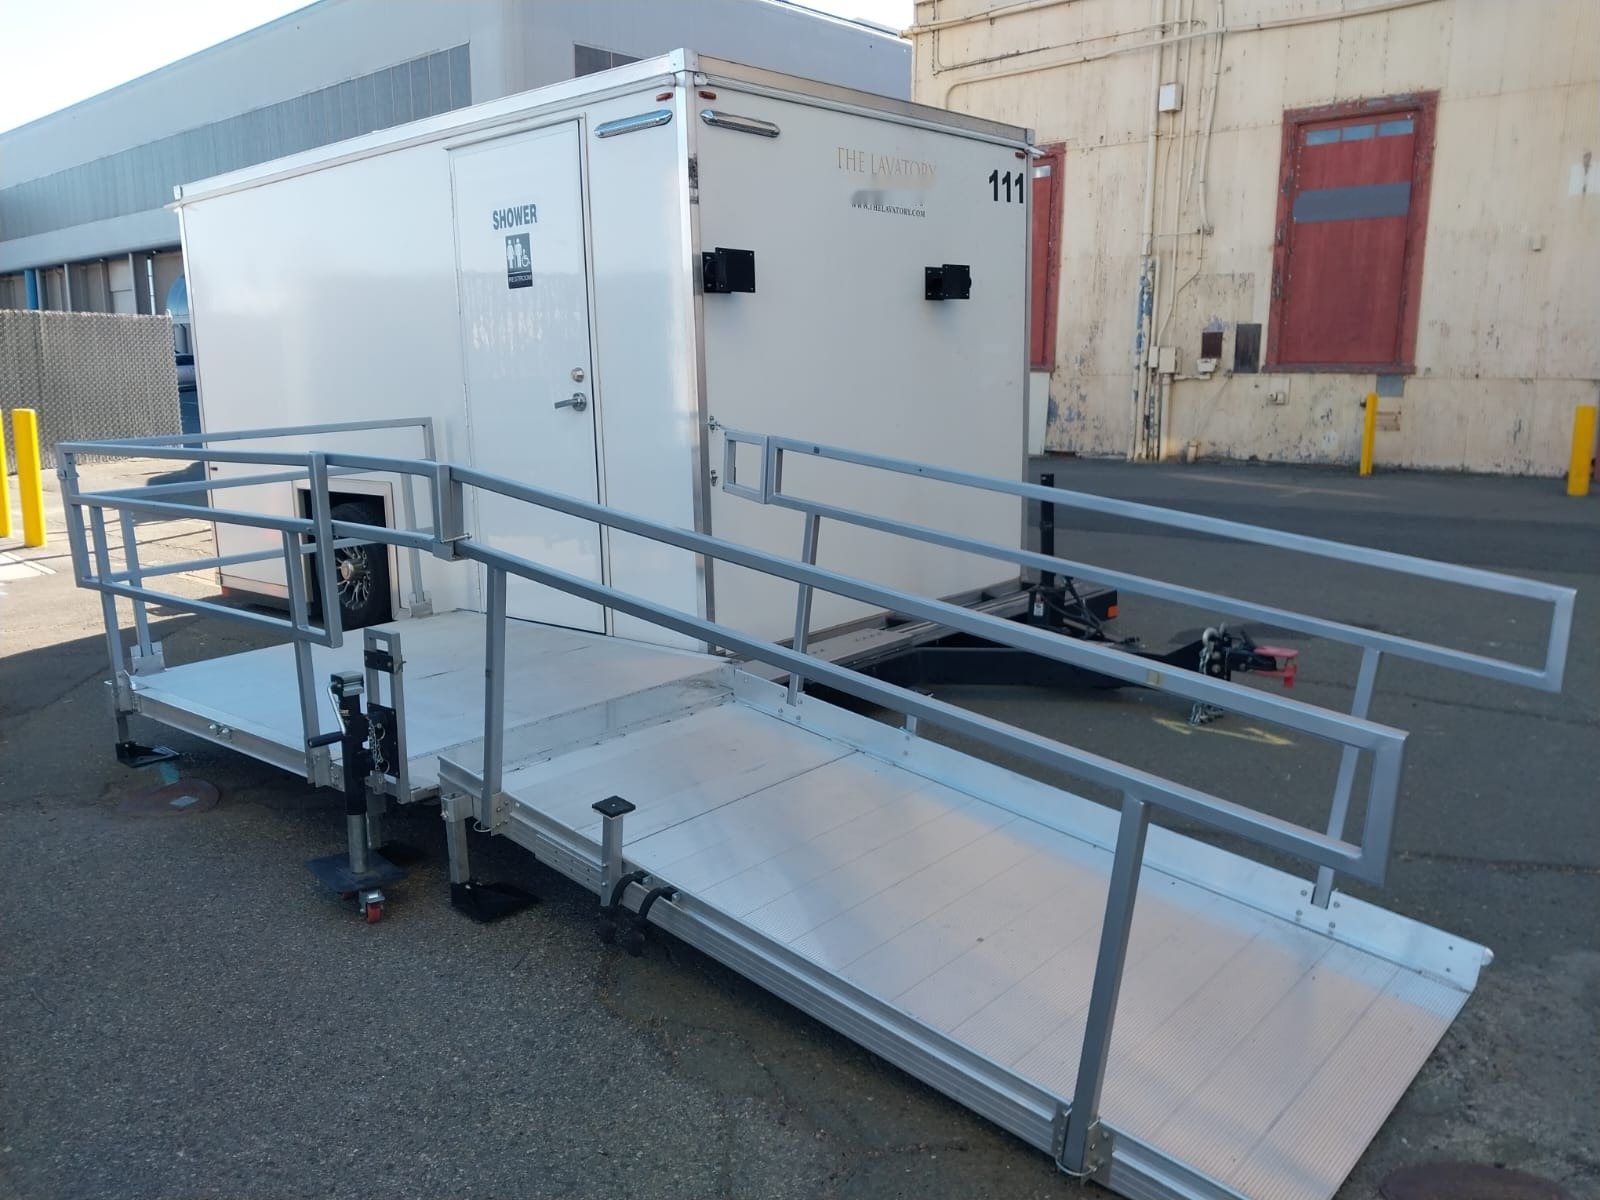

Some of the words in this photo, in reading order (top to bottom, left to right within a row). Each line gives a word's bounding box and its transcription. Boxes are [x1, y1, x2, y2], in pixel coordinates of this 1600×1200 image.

[838, 147, 865, 173] THE
[871, 153, 937, 176] LAVATORY
[989, 169, 1024, 204] 111
[492, 204, 537, 230] SHOWER
